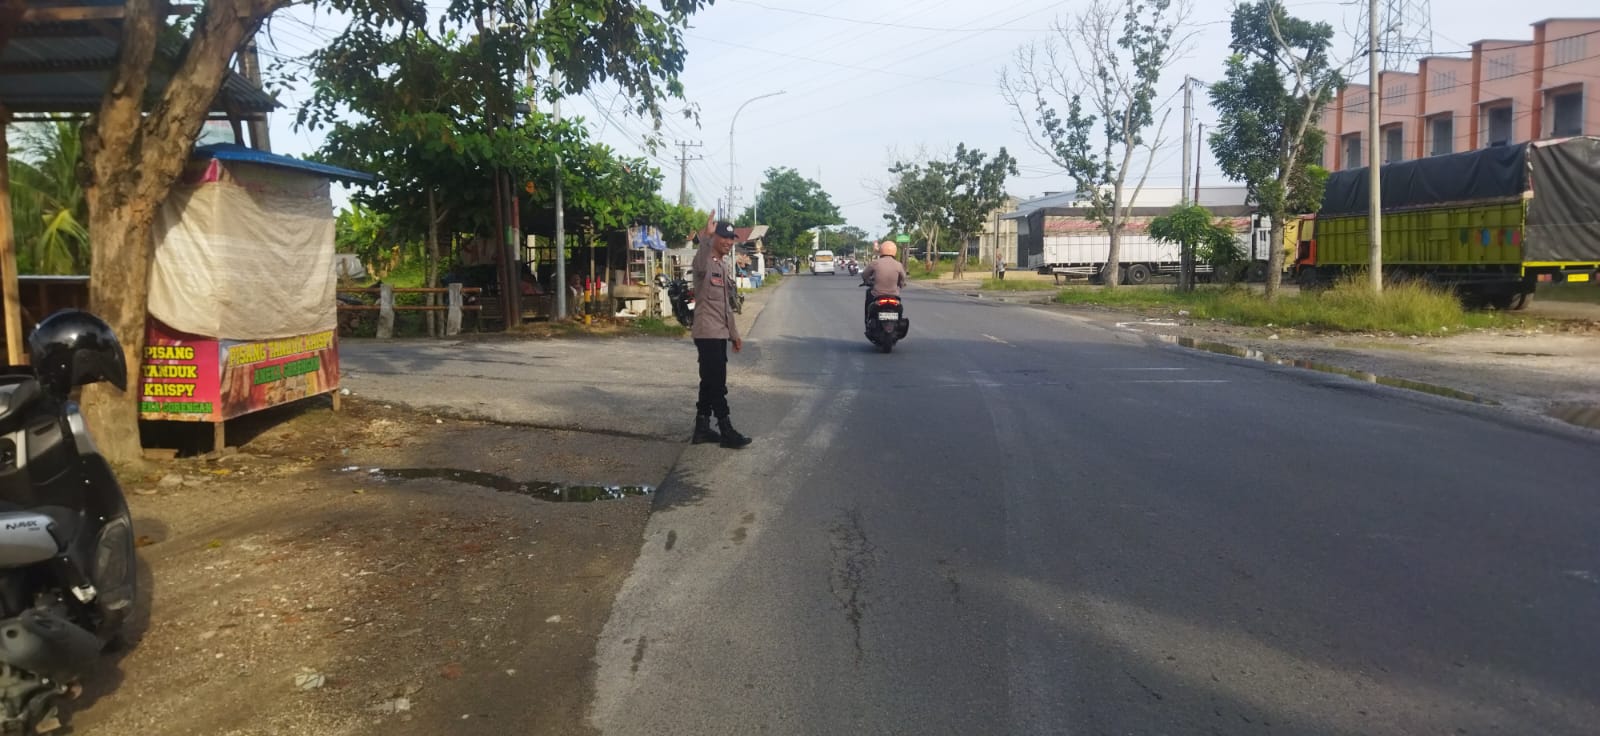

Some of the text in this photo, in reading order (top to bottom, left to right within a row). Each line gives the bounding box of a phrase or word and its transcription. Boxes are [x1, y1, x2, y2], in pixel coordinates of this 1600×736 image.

[143, 346, 194, 360] PISANG
[229, 331, 334, 367] PISANG TANDUK KRISPY
[143, 364, 197, 378] TANDUK
[254, 364, 281, 385] ANEKA
[144, 383, 195, 397] KRISPY
[138, 401, 160, 412] EKA
